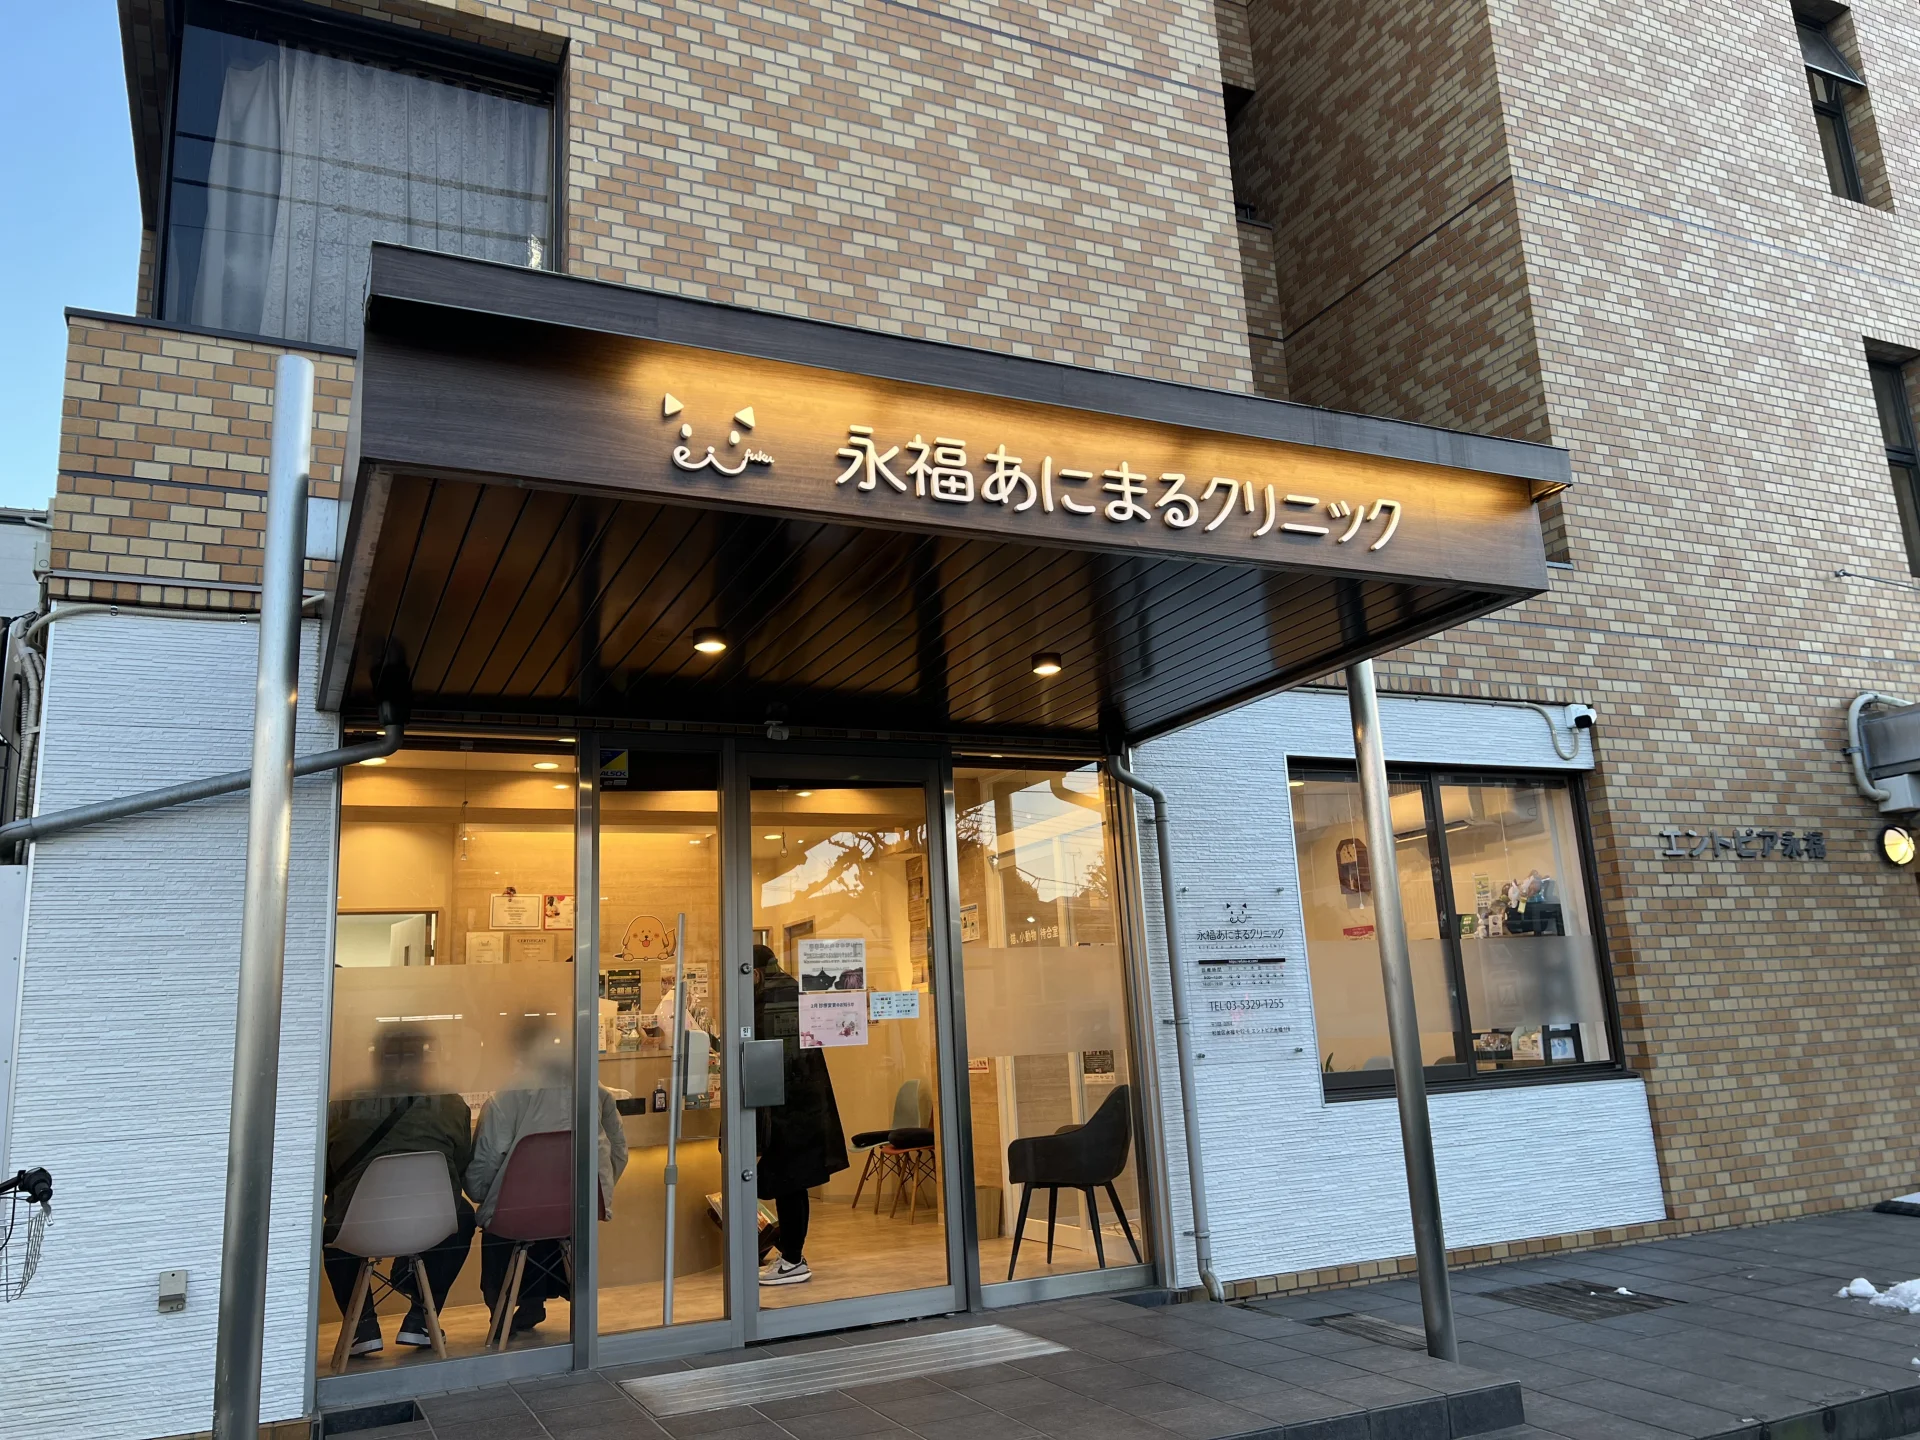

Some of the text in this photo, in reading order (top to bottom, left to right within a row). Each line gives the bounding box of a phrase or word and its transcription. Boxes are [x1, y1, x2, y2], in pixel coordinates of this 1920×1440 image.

[836, 424, 1402, 551] 永福あにまるクリニック
[1660, 829, 1827, 859] エントピア永福
[1196, 929, 1285, 940] 永福あにまるクリニック
